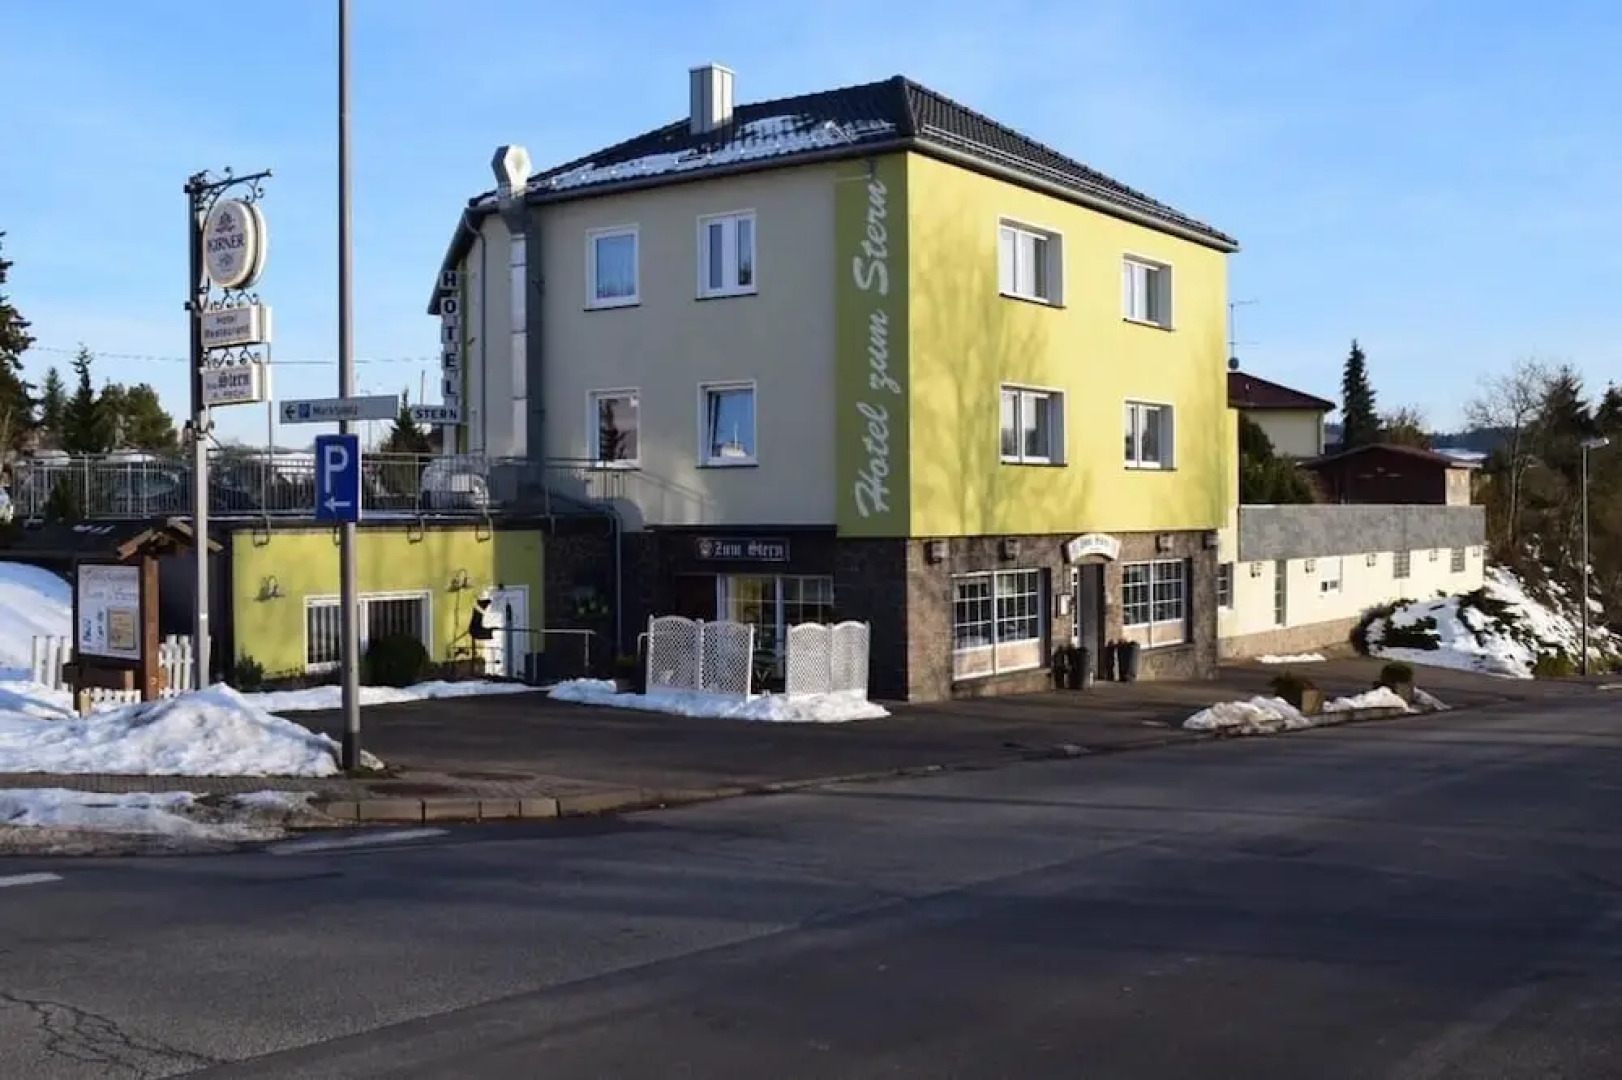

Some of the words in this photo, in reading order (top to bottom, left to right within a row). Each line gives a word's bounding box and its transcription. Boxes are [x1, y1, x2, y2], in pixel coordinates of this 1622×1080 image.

[853, 179, 889, 295] Stern
[443, 272, 457, 395] HOTEL
[869, 309, 901, 394] zum
[415, 408, 457, 419] STERN
[855, 402, 890, 518] Hotel
[323, 445, 348, 494] P
